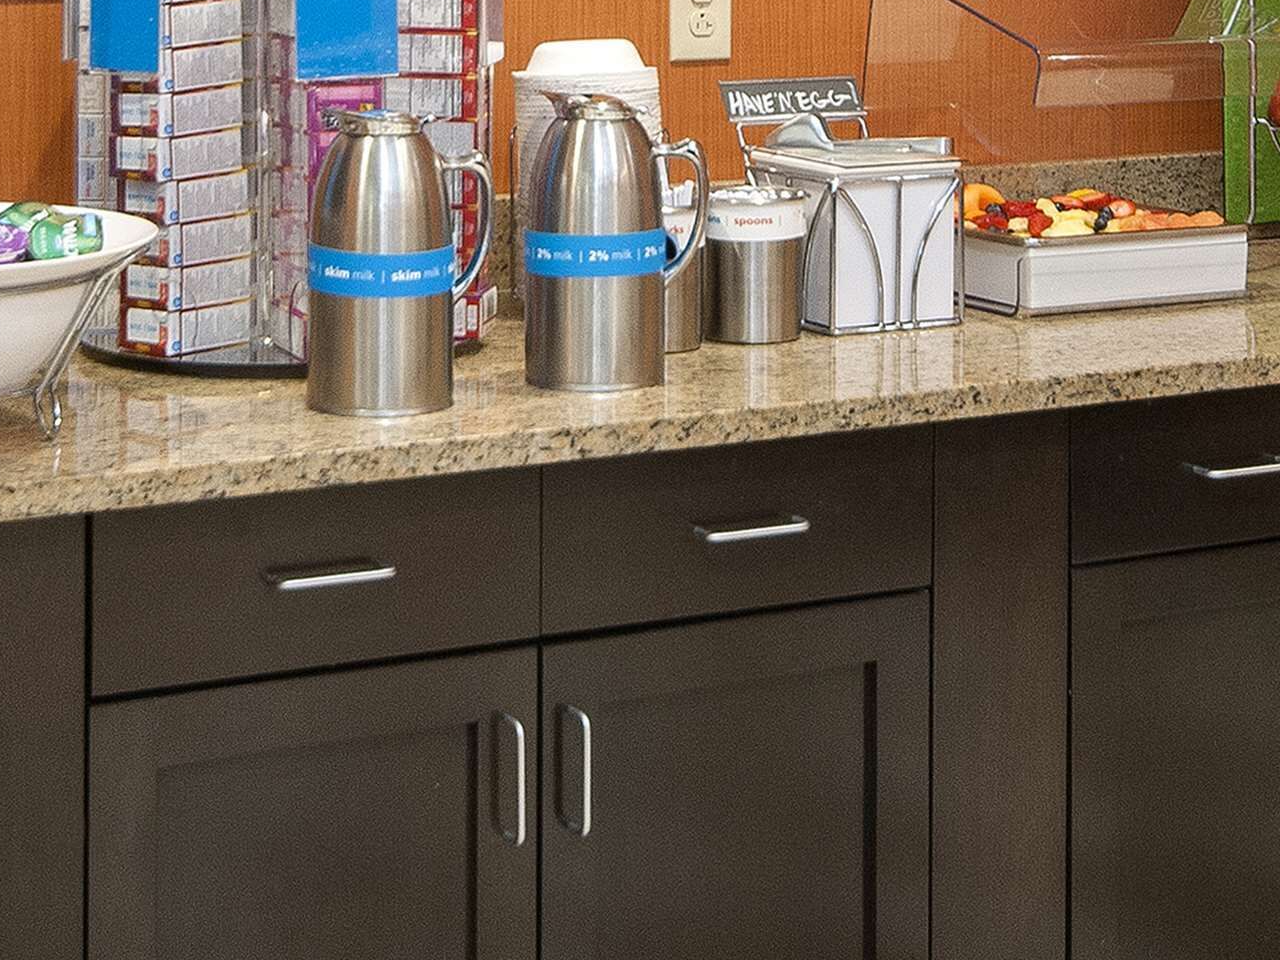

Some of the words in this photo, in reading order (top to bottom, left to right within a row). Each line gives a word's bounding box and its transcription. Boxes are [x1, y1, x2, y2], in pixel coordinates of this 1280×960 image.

[733, 215, 774, 228] spoons
[537, 247, 552, 260] 2%
[588, 249, 610, 262] 2%
[324, 265, 350, 280] skim
[351, 270, 376, 282] milk
[391, 267, 422, 282] skim
